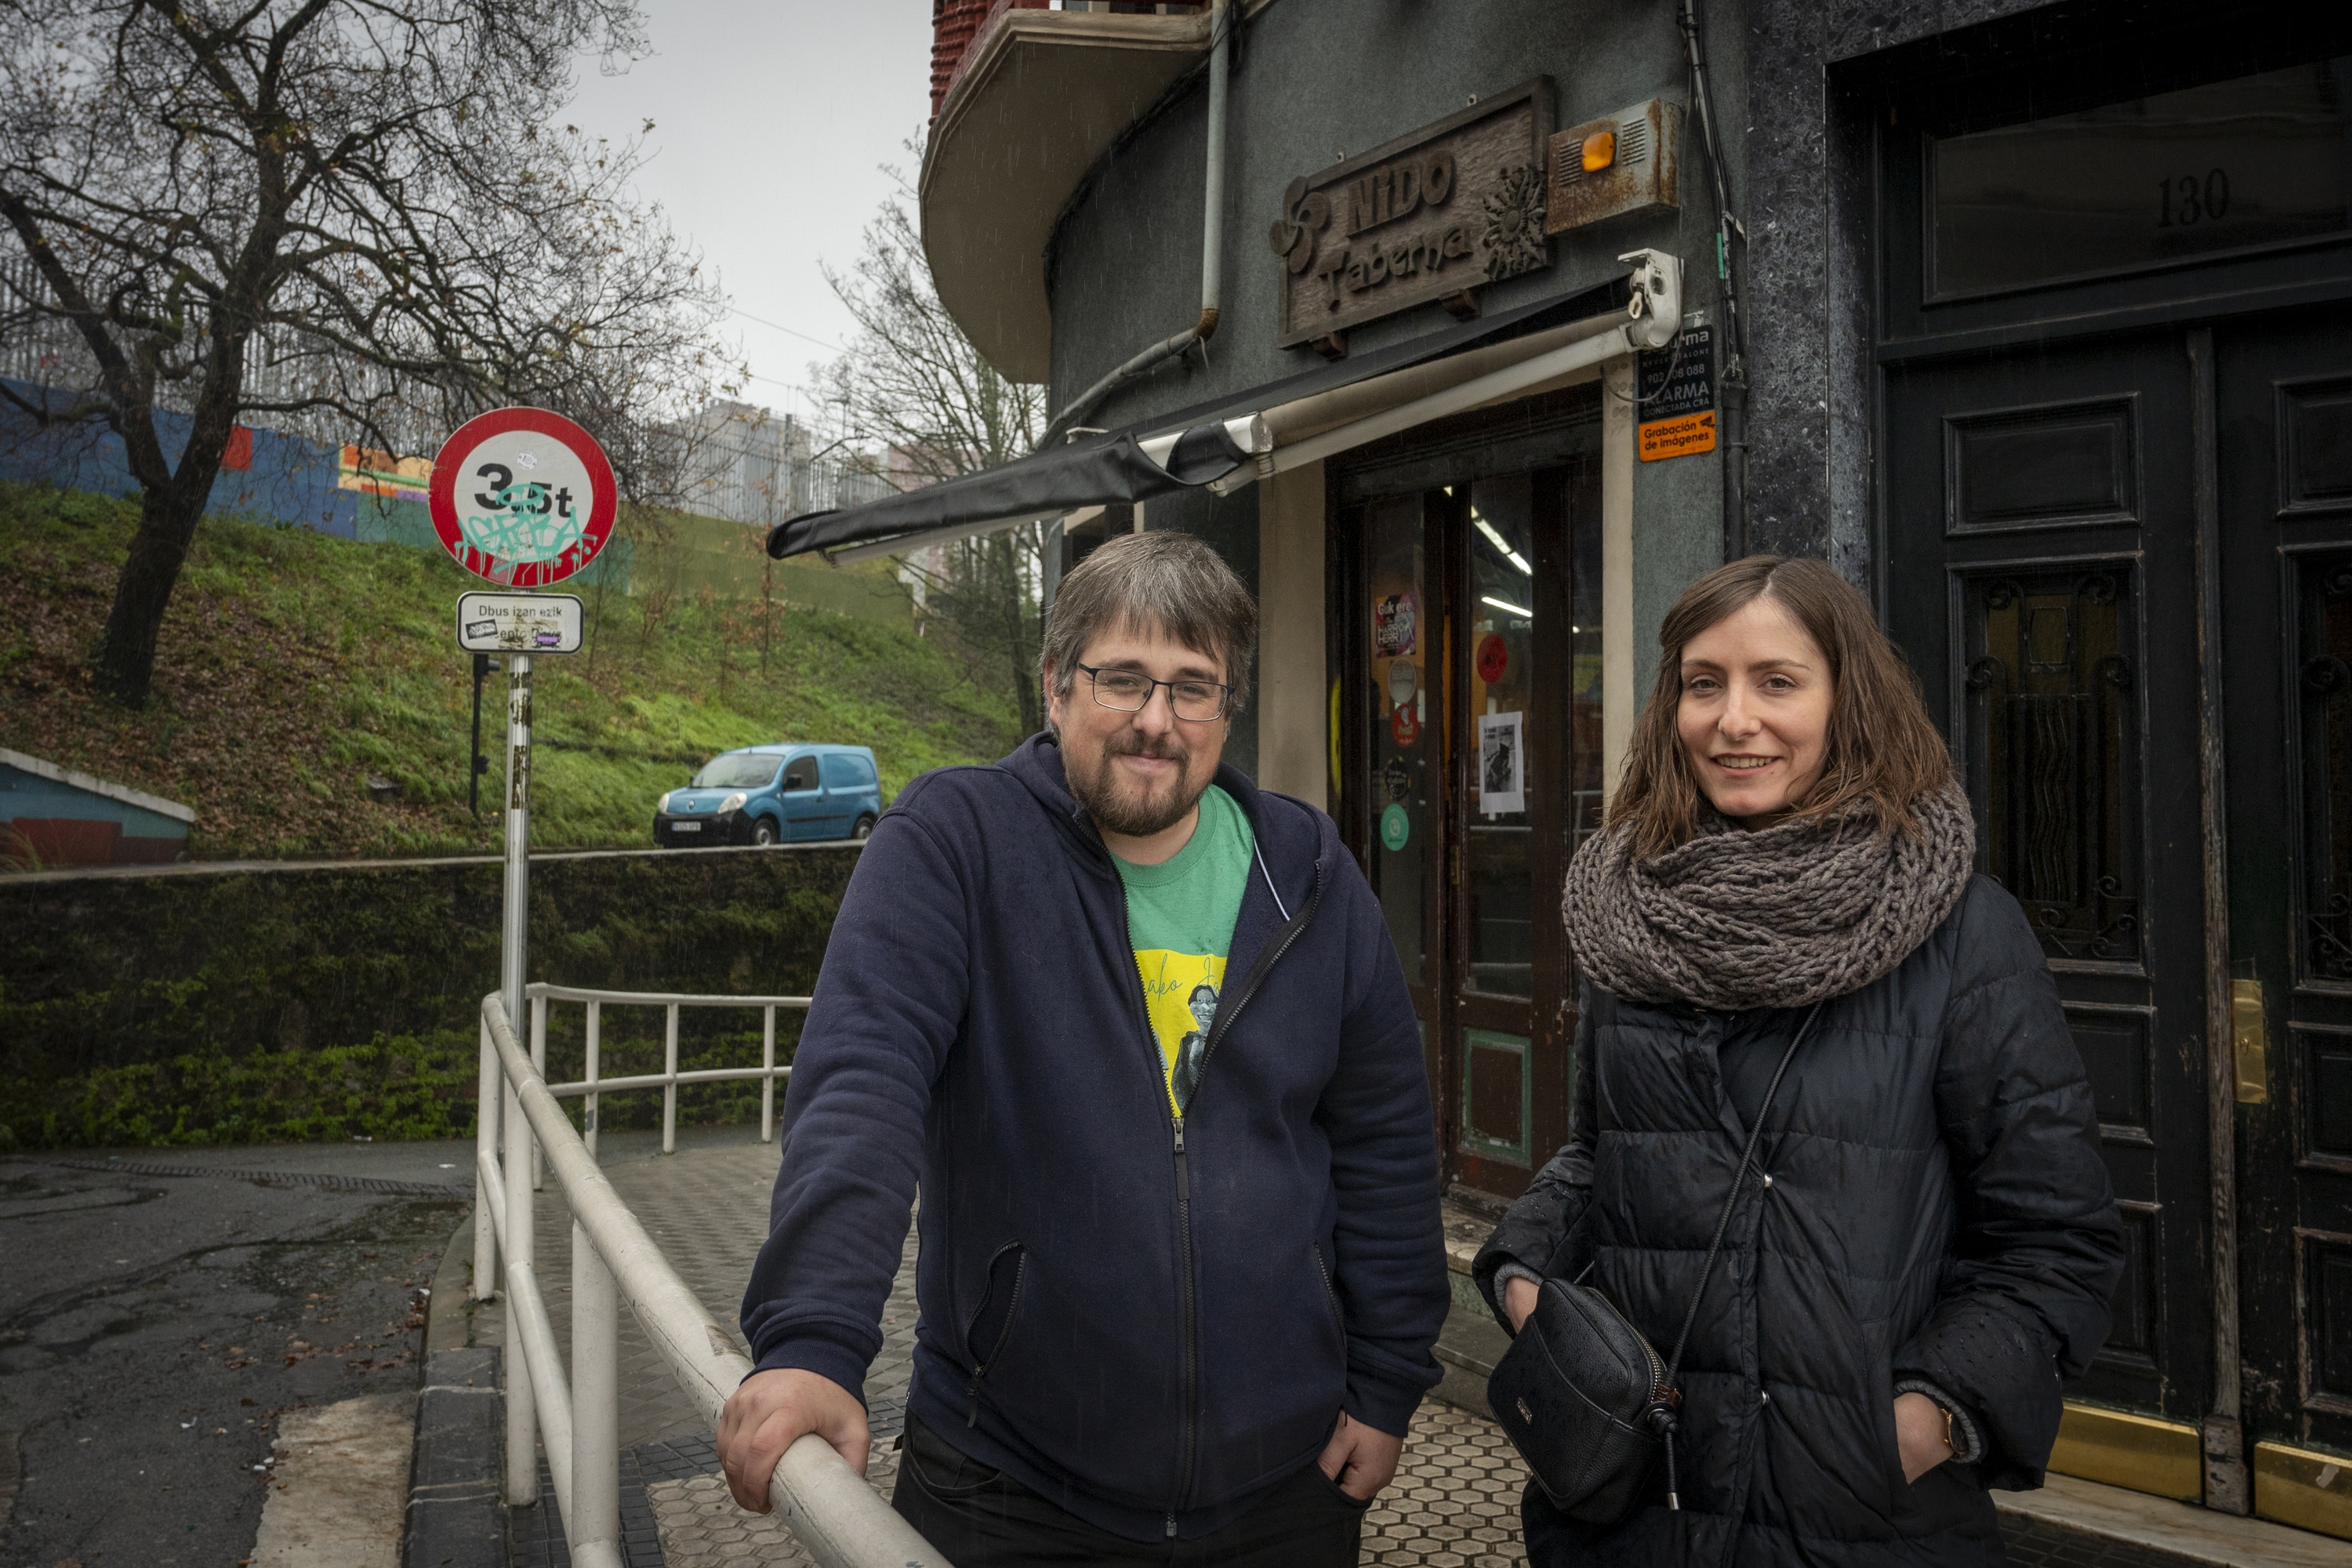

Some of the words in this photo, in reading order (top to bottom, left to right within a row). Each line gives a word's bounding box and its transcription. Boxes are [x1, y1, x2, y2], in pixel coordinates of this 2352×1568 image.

[2158, 168, 2230, 228] 130
[1318, 225, 1474, 311] Taberna
[1683, 347, 1709, 359] ALONE
[1647, 372, 1664, 384] 902
[1686, 364, 1705, 377] 088
[1644, 380, 1709, 407] ALARMA
[1643, 401, 1691, 416] CONECTADA
[1693, 397, 1709, 408] CRA
[1644, 420, 1697, 438] Grabación
[1645, 438, 1657, 451] de
[1660, 431, 1709, 449] imágenes
[479, 604, 509, 617] Dbus
[513, 605, 536, 618] izan
[540, 606, 562, 618] ezik
[1377, 601, 1394, 615] Guk
[1396, 602, 1411, 612] ere
[1145, 953, 1183, 1003] ako
